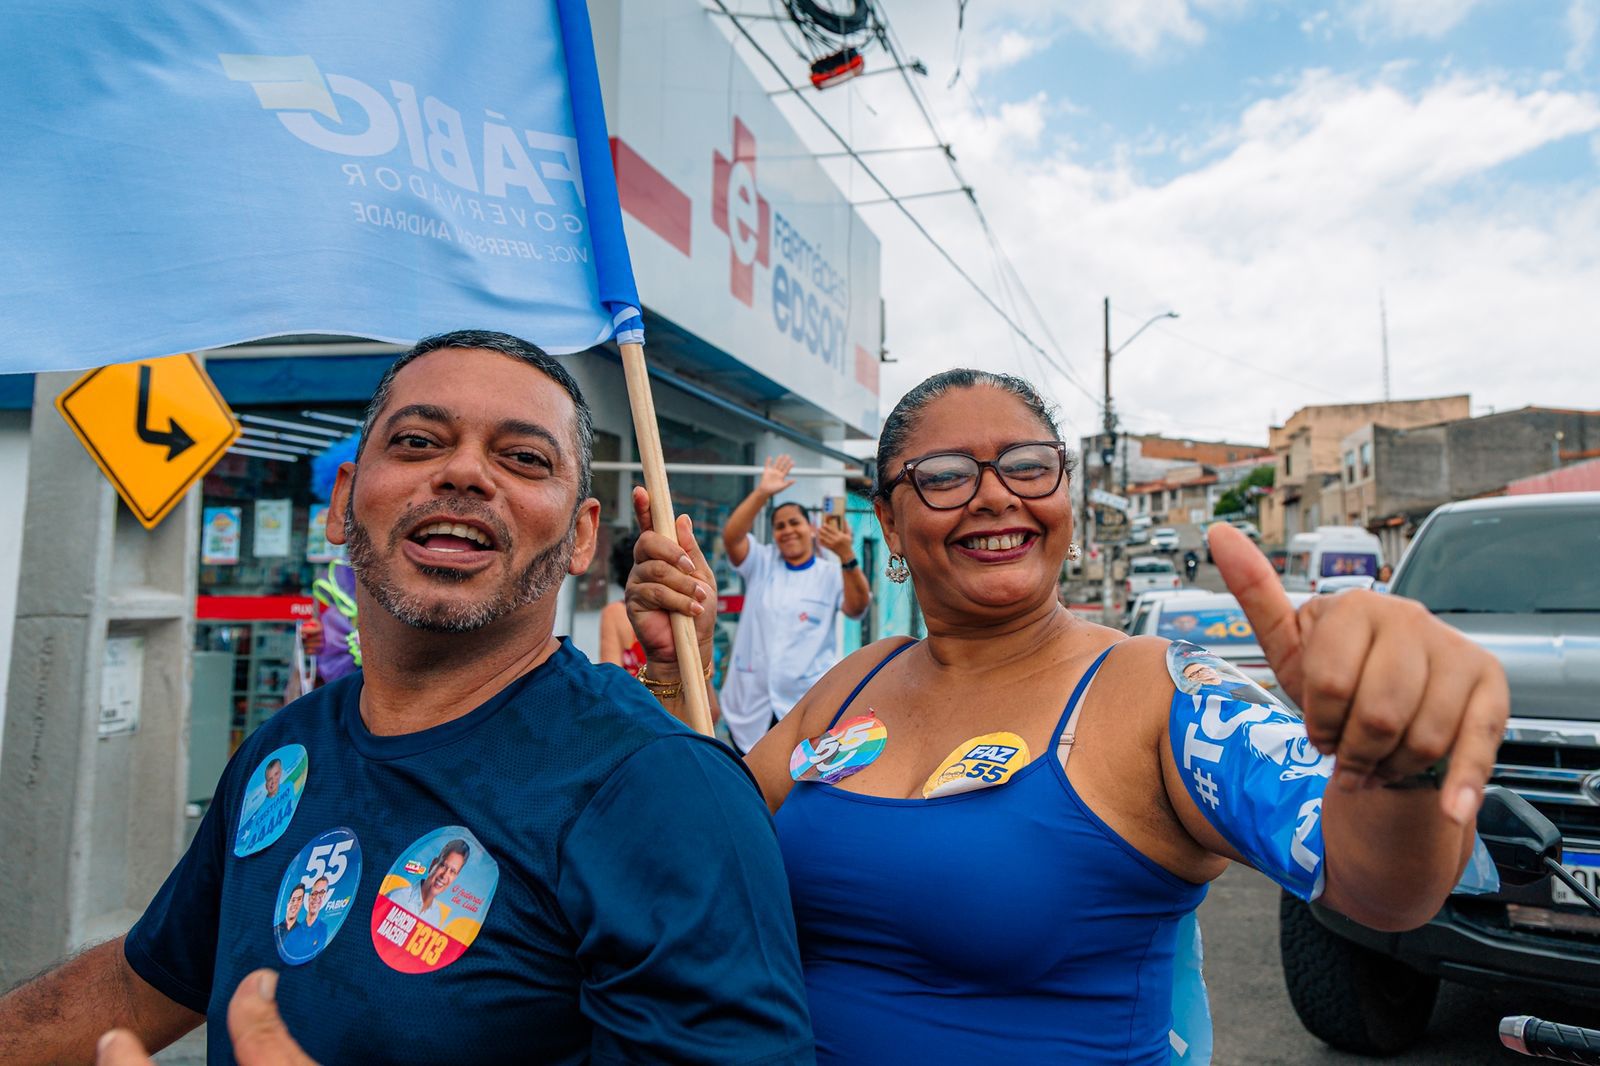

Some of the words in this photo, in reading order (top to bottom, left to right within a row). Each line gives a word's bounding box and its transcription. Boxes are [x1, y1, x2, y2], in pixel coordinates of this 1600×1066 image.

[809, 720, 877, 763] 55
[967, 744, 1018, 763] FAZ
[966, 763, 1008, 783] 55
[300, 838, 354, 890] 55
[404, 921, 449, 966] 1313
